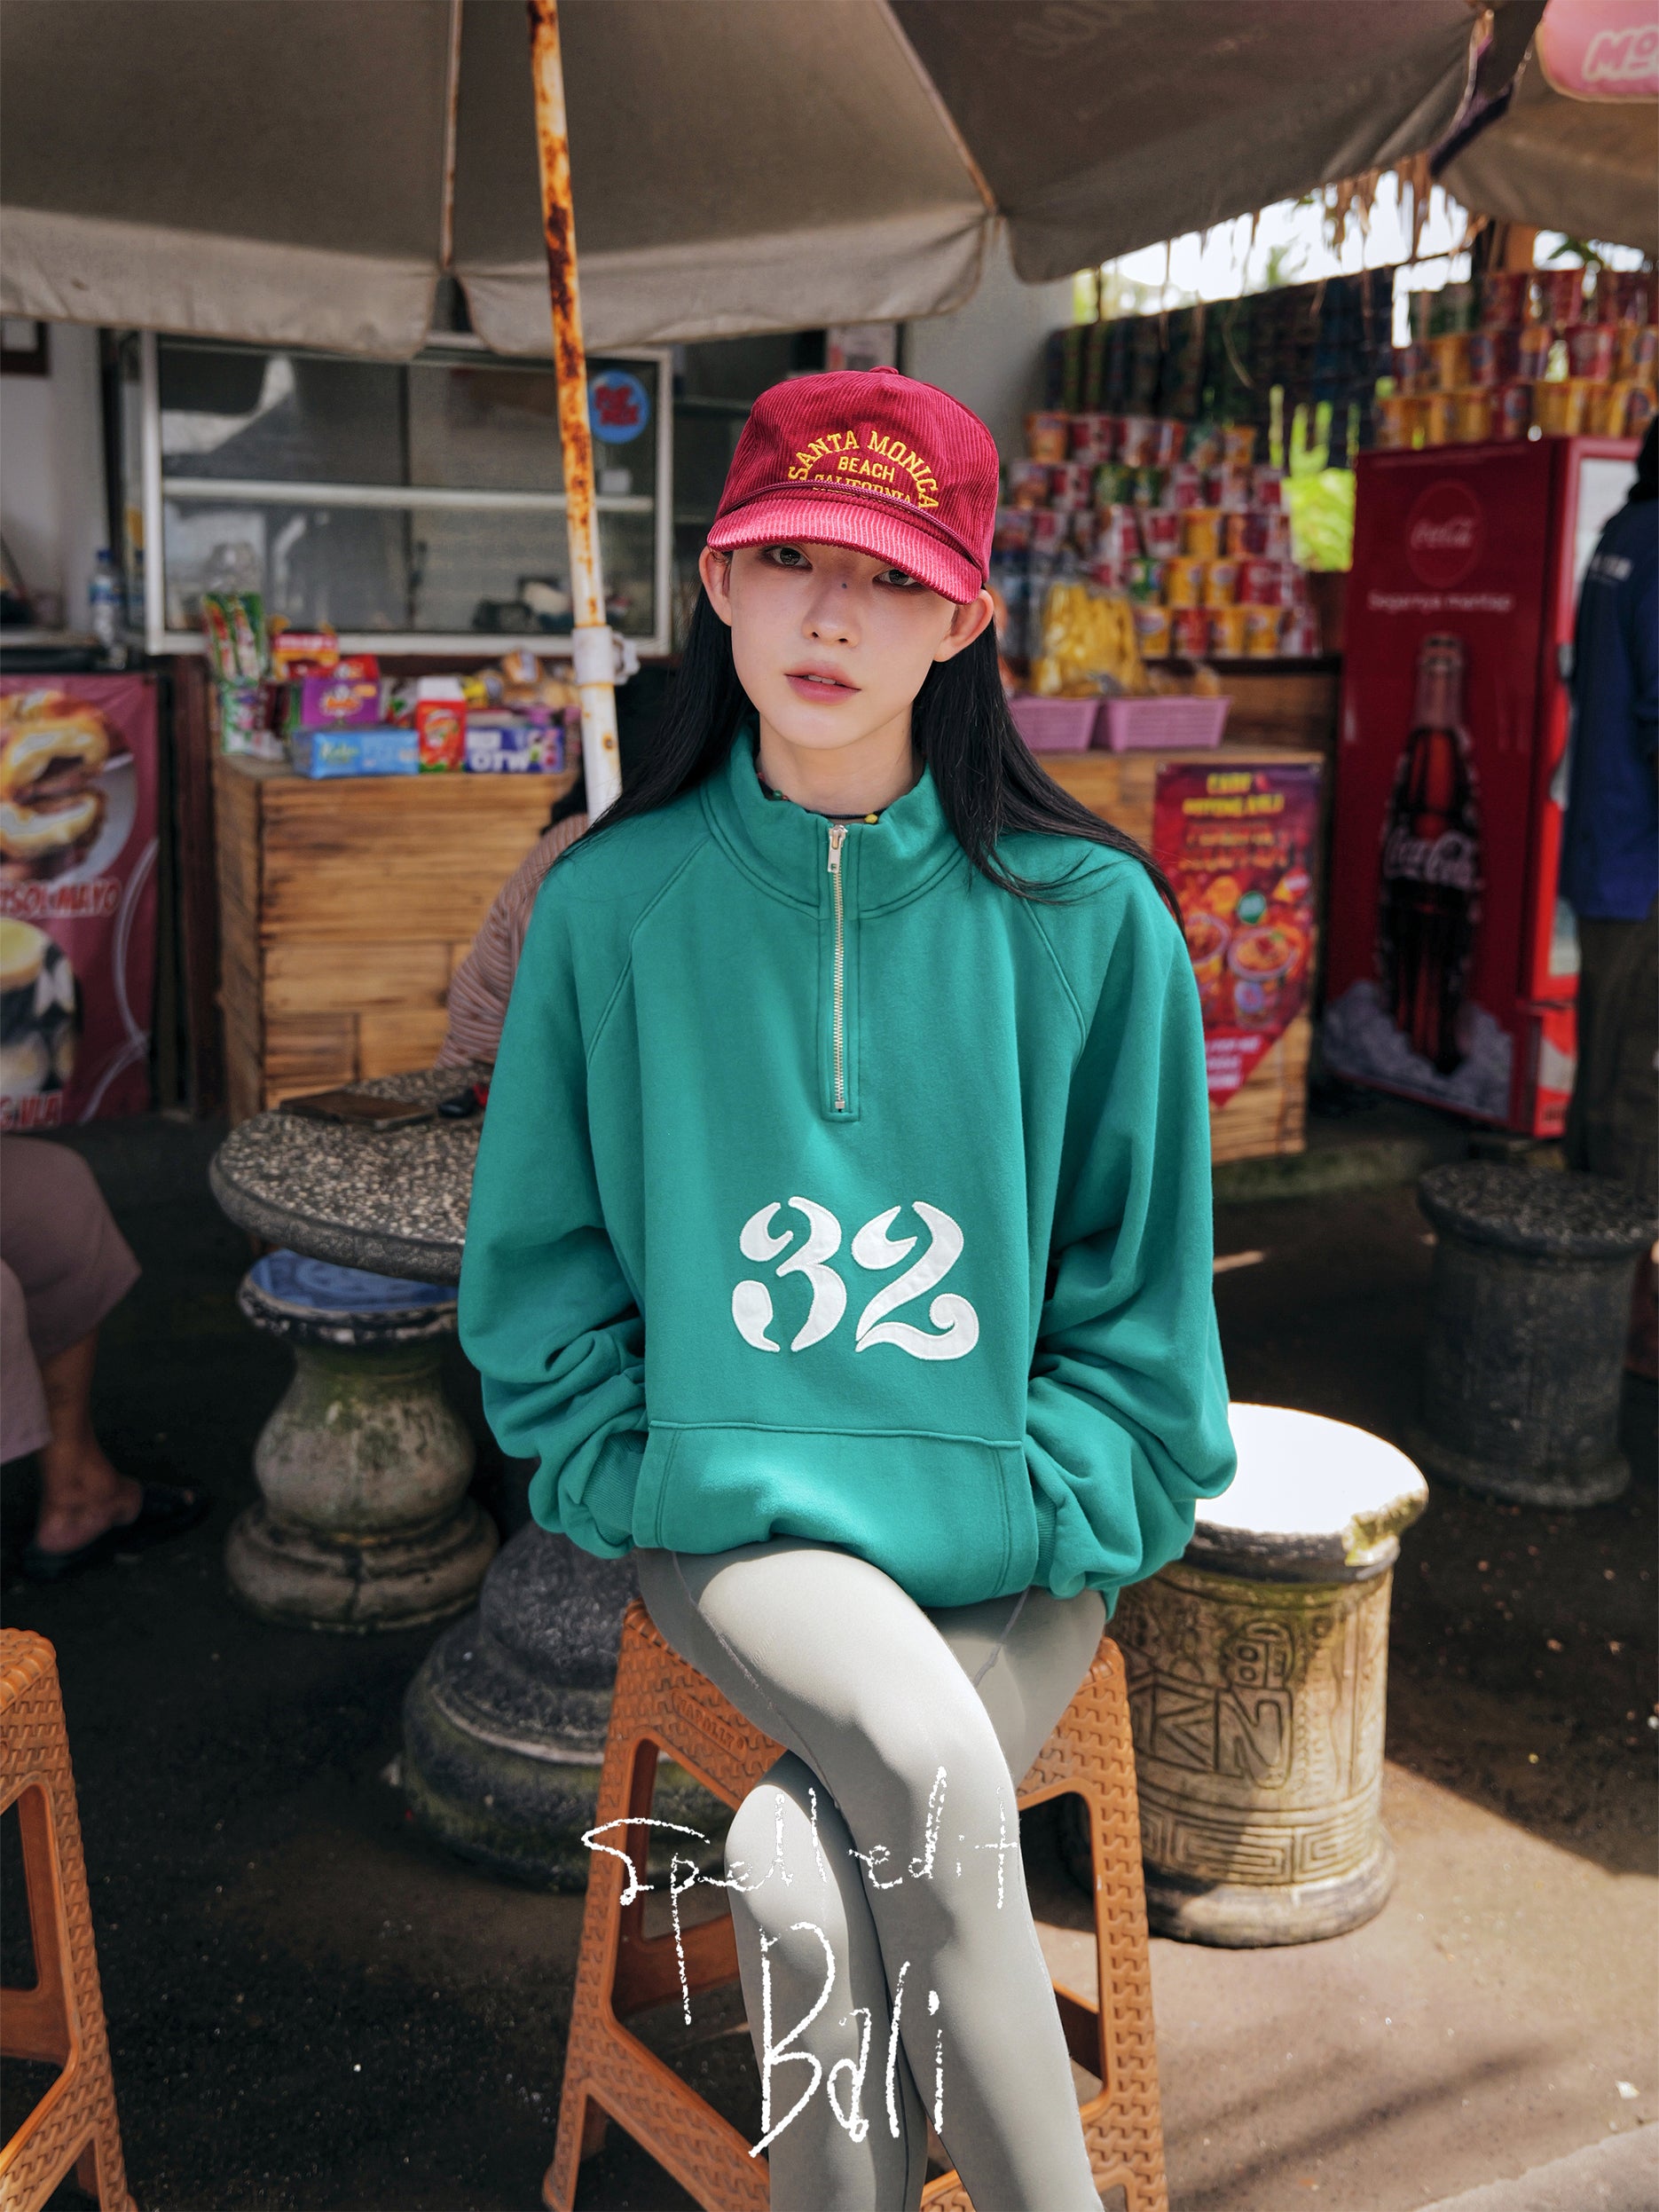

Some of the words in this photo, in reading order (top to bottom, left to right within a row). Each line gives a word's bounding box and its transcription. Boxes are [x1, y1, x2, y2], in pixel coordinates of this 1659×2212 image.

[787, 429, 860, 481] SANTA
[867, 429, 940, 508] MONICA
[837, 455, 895, 484] BEACH
[732, 1196, 979, 1360] 32
